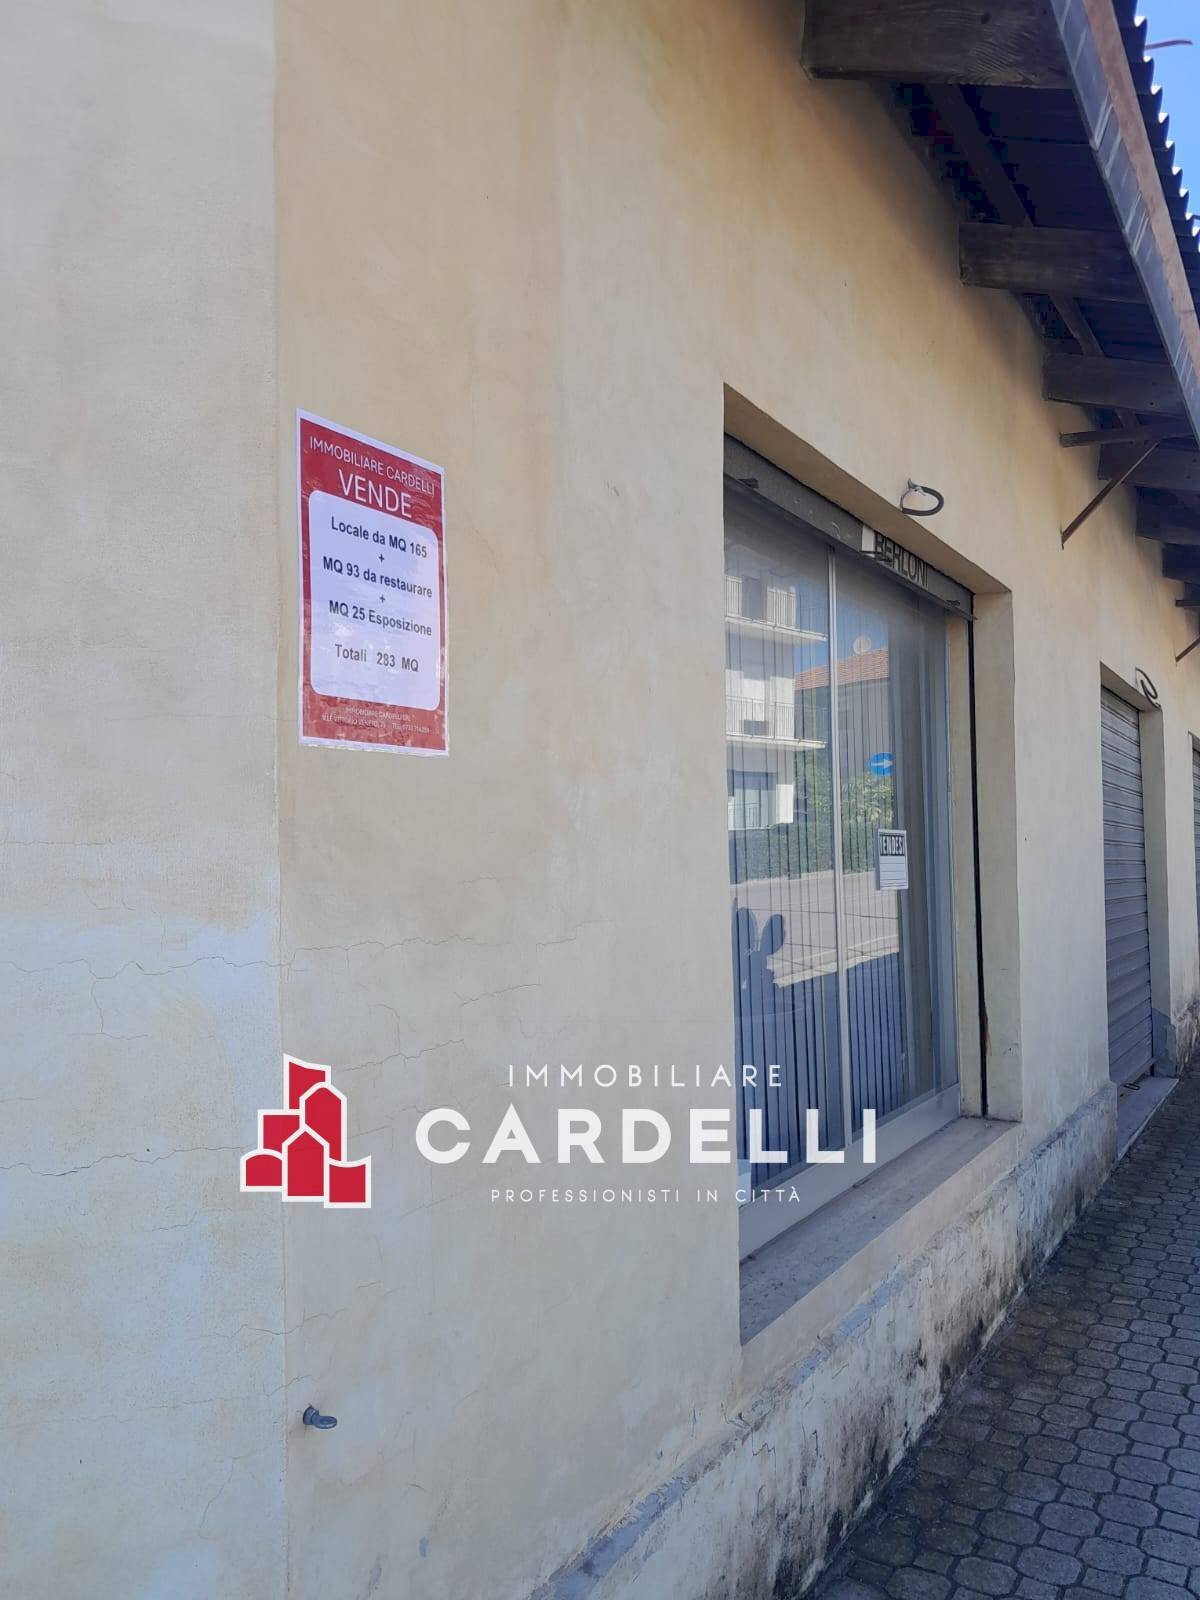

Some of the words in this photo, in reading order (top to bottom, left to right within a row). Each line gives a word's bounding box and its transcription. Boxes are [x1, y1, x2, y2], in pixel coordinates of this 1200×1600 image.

[310, 435, 384, 476] IMMOBILIARE
[386, 466, 435, 498] CARDELLI
[338, 468, 413, 518] VENDE
[331, 516, 370, 540] Locale
[372, 531, 386, 545] da
[389, 535, 407, 552] MQ
[410, 542, 428, 558] 165
[323, 556, 343, 574] MQ
[346, 562, 360, 578] 93
[363, 568, 377, 583] da
[380, 574, 433, 598] restaurare
[329, 600, 349, 618] MQ
[352, 605, 366, 621] 25
[368, 610, 432, 636] Esposizione
[335, 643, 367, 662] Totali
[376, 652, 396, 668] 283
[401, 657, 419, 672] MQ
